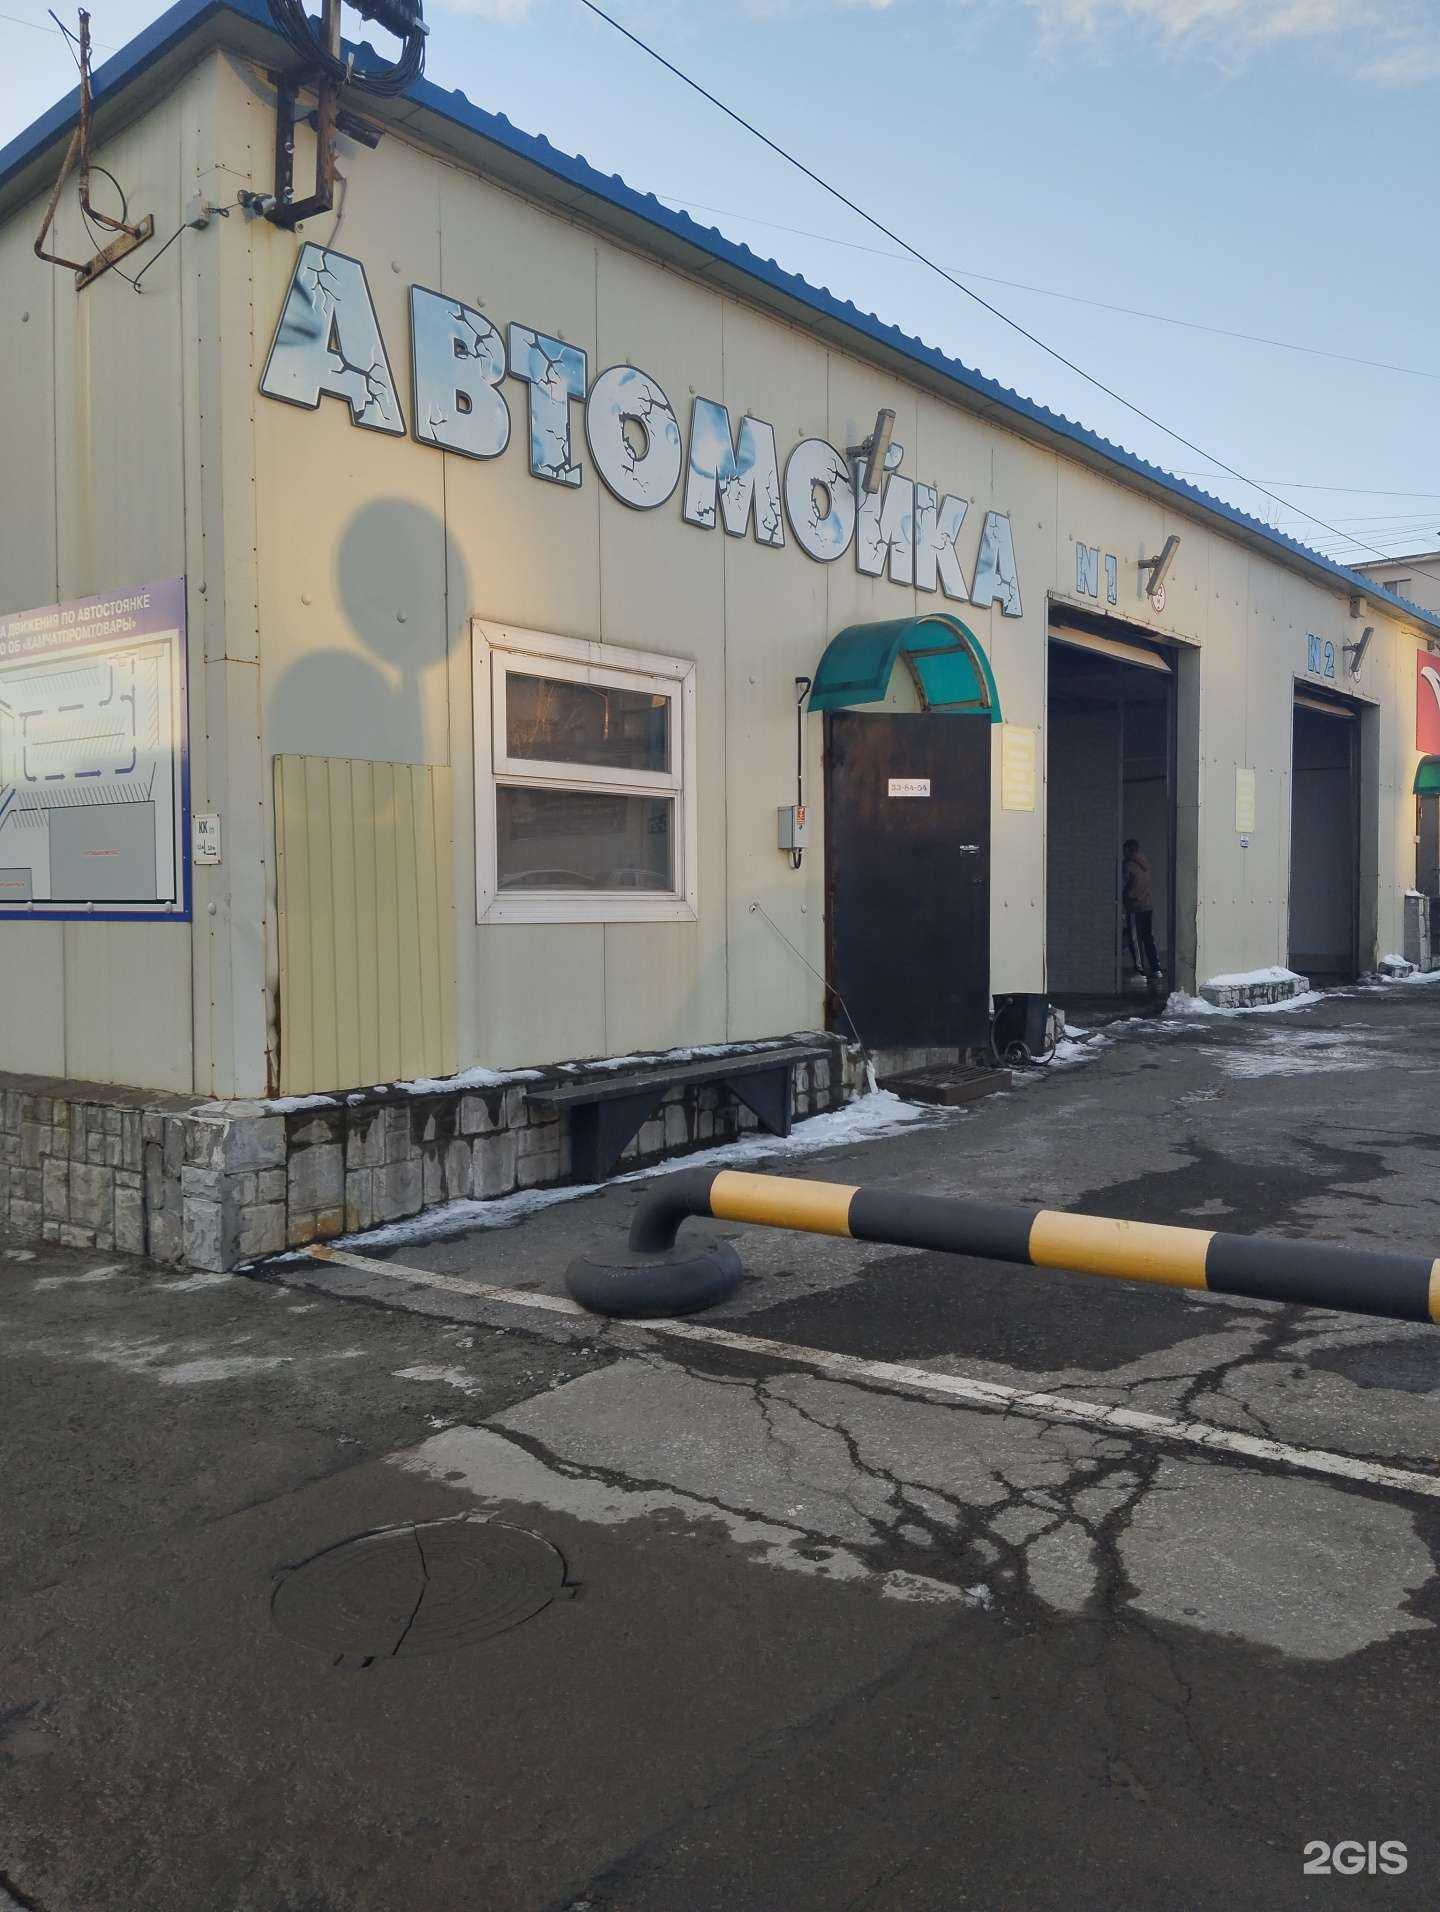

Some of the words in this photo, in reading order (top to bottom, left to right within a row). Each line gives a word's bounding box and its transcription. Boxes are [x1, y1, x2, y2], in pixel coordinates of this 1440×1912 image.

[259, 240, 1024, 618] АВТОМОЙКА
[61, 610, 76, 625] ПО
[77, 594, 151, 621] АВТОСТОЯНКЕ
